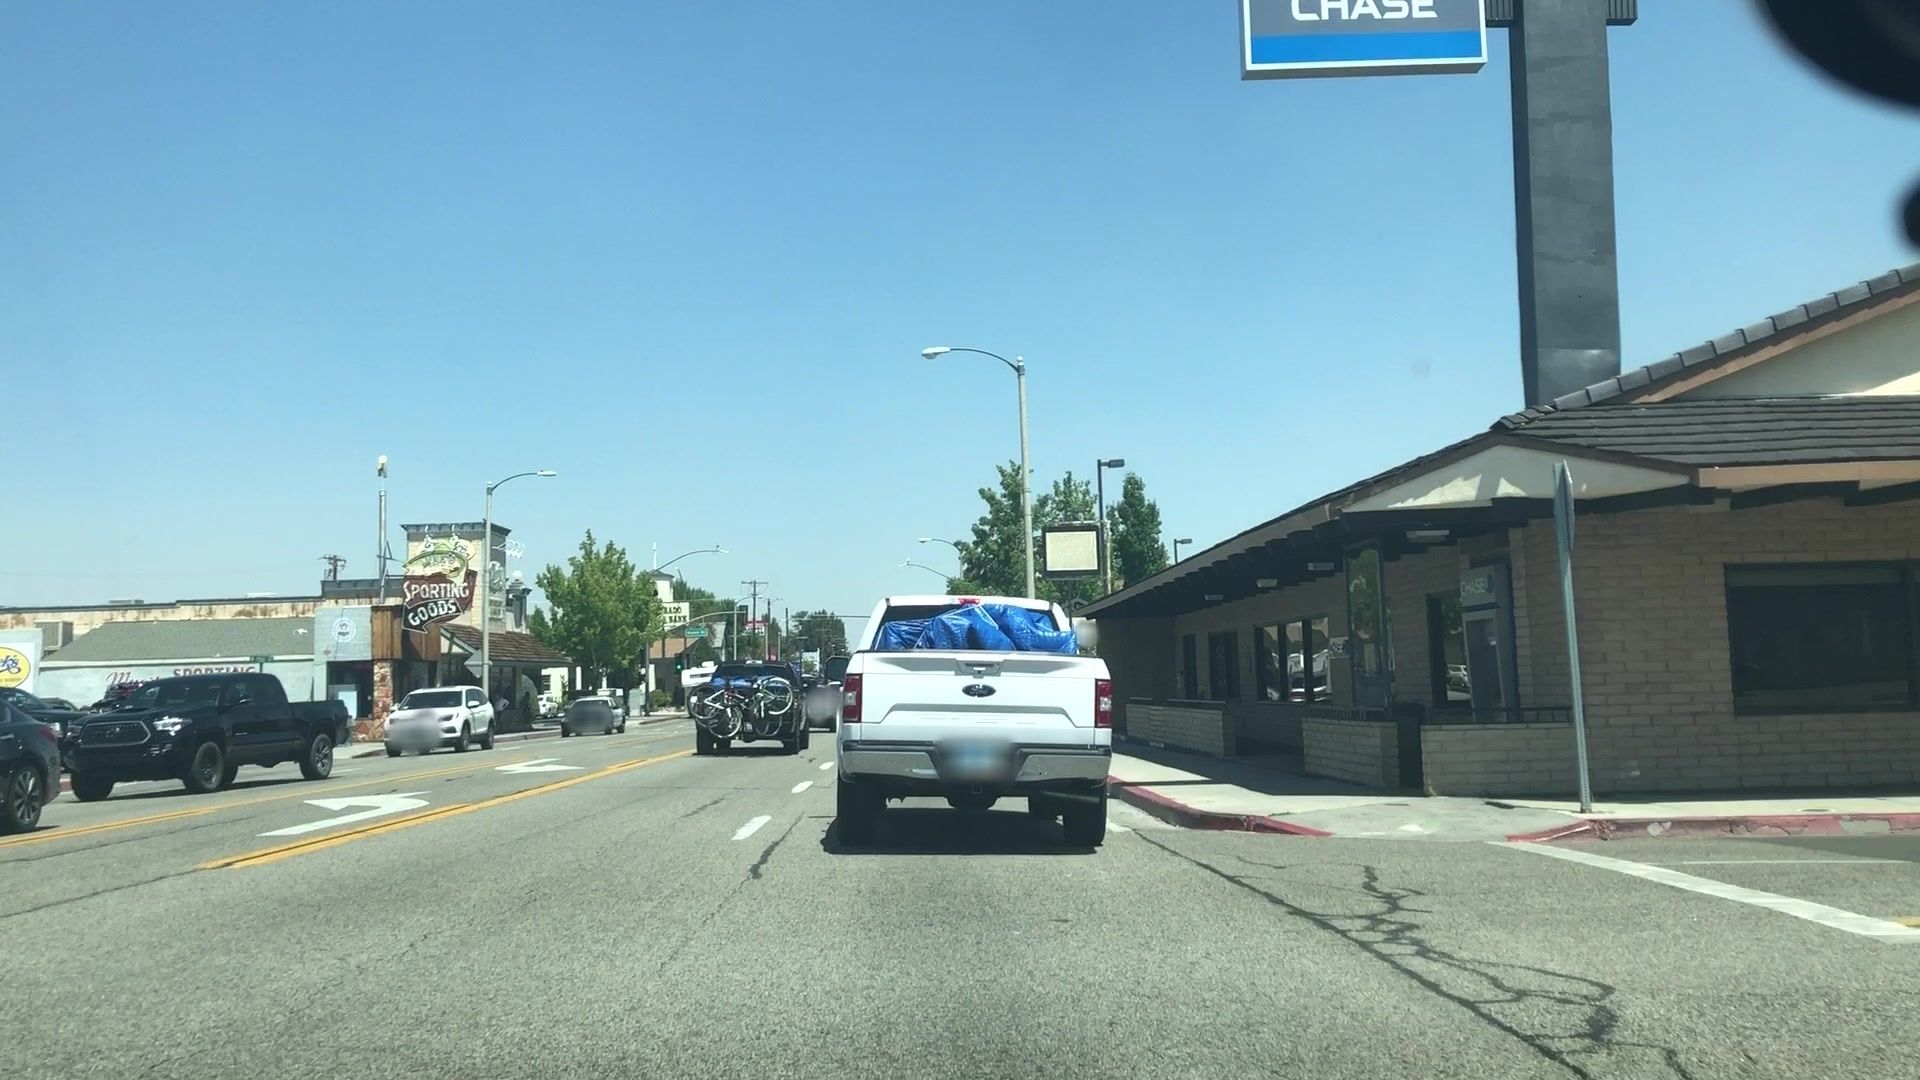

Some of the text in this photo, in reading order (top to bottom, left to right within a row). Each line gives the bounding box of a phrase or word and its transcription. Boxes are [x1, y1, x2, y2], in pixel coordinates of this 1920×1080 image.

[1291, 0, 1438, 21] CHASE
[403, 580, 470, 602] SPORTING
[407, 599, 457, 626] GOODS
